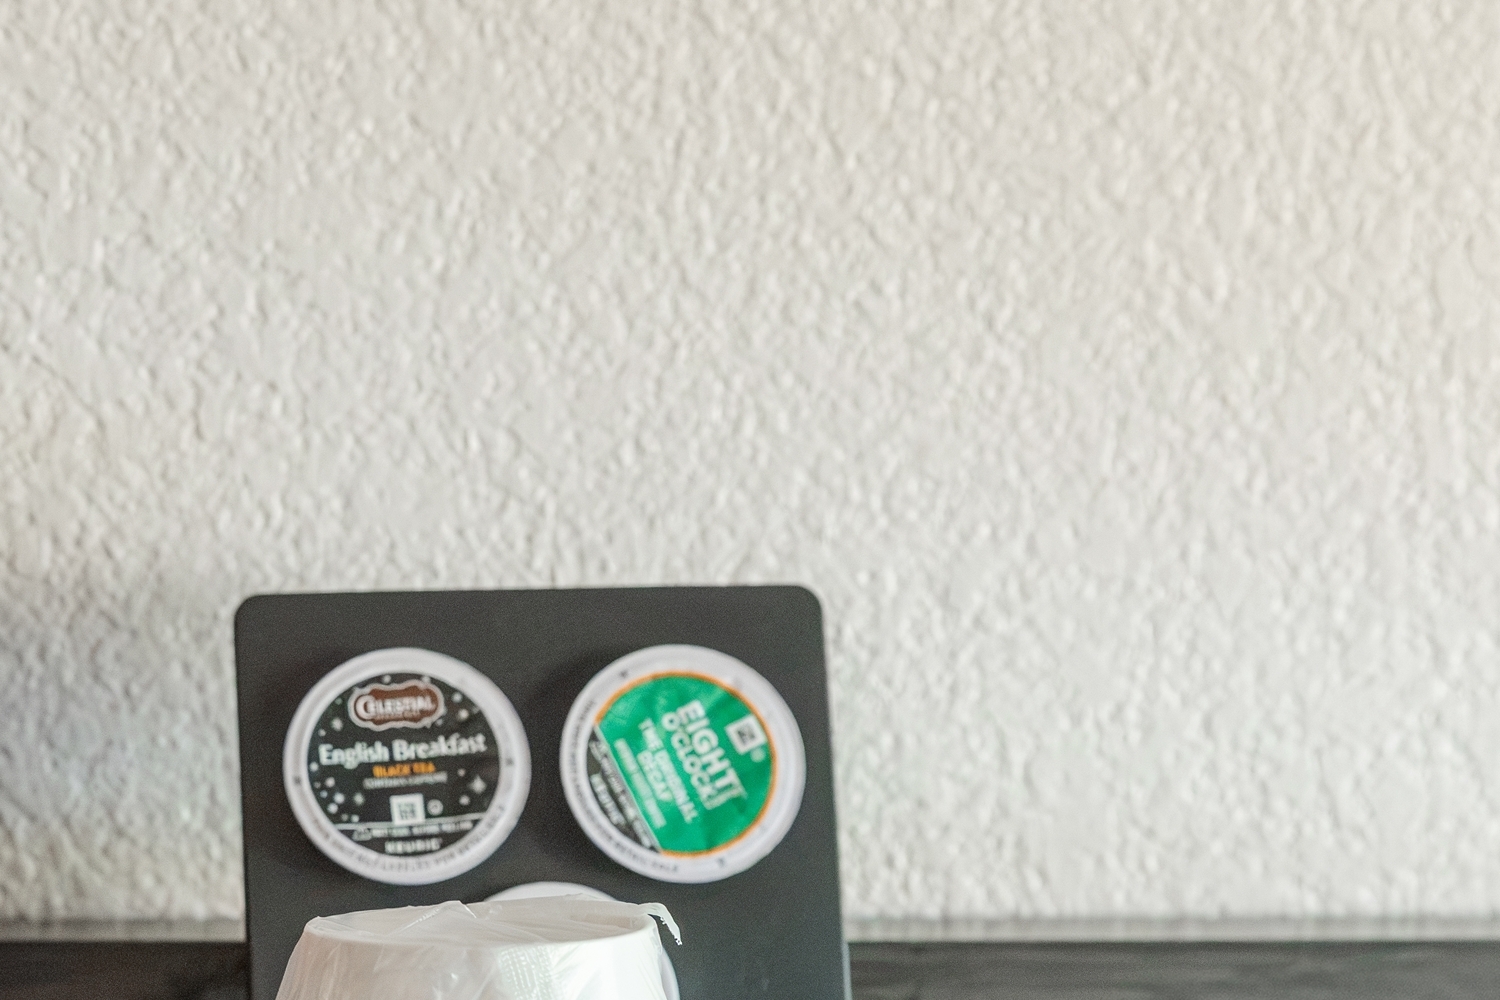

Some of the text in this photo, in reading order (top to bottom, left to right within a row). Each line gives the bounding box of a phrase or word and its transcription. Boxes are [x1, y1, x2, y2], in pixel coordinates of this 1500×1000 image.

[318, 732, 488, 769] English Breakfast
[676, 699, 740, 792] EIGHT
